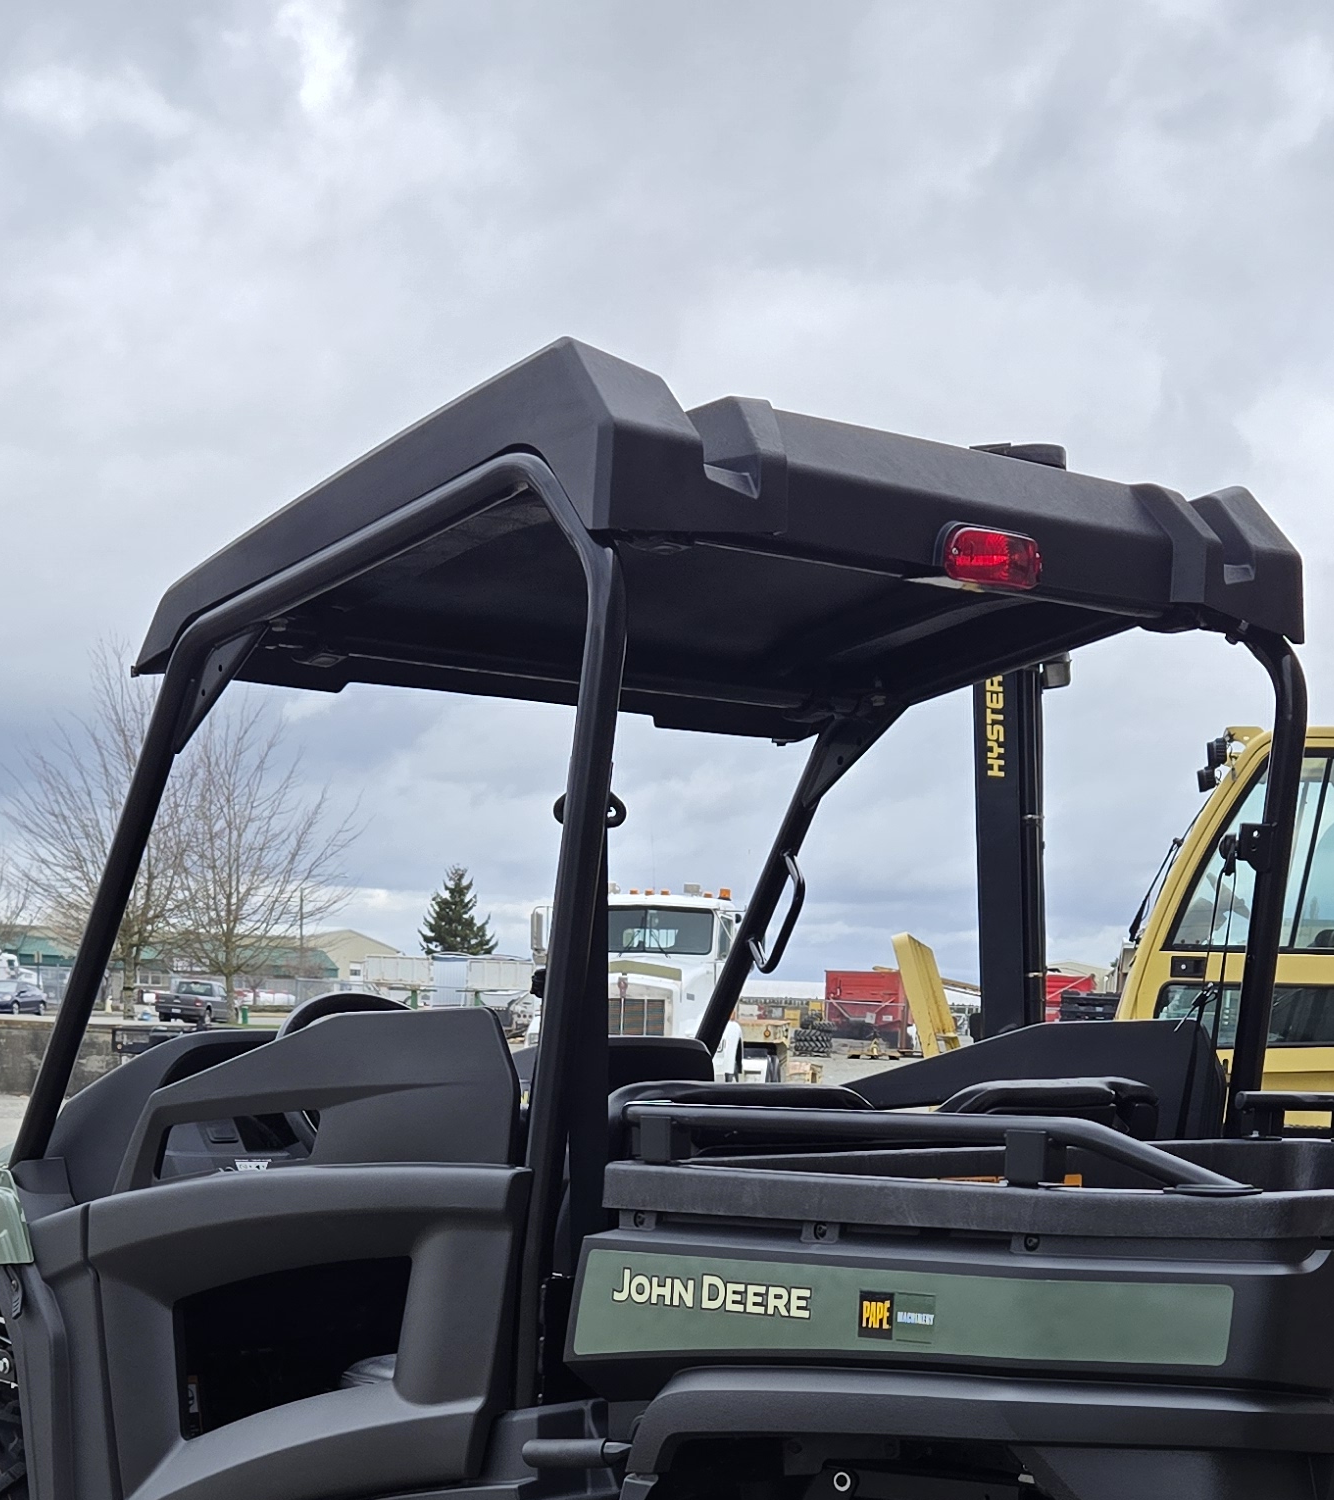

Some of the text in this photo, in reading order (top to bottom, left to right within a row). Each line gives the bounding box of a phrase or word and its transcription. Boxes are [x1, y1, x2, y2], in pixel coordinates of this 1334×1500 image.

[984, 674, 1006, 778] HYSTER
[612, 1267, 812, 1320] JOHN DEERE
